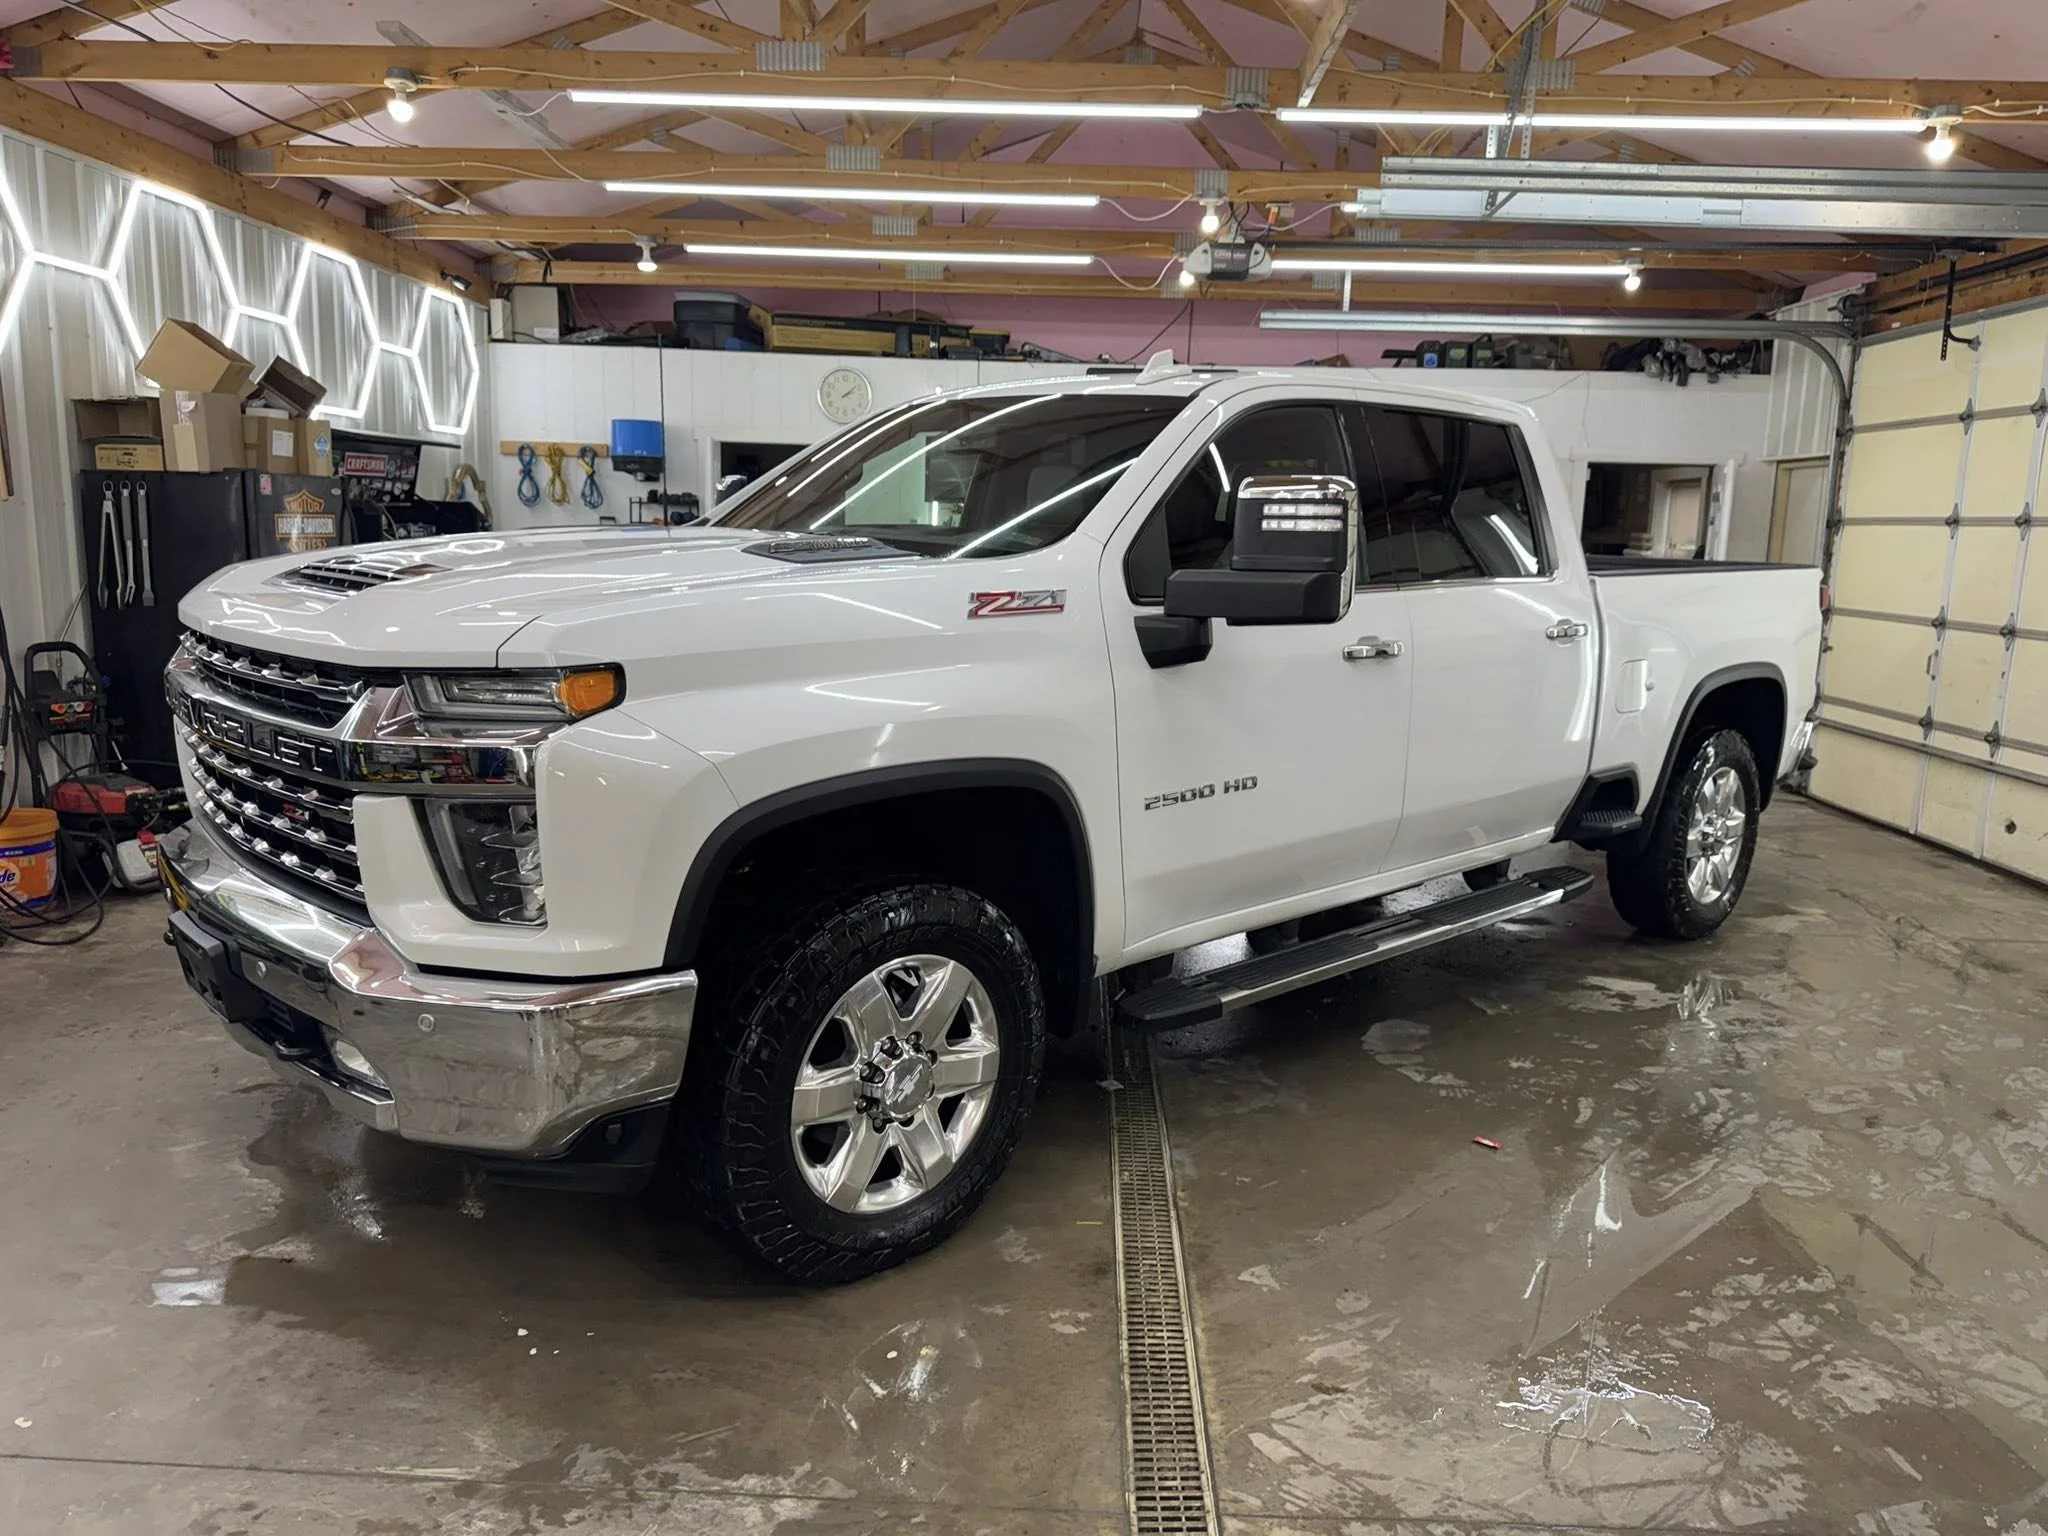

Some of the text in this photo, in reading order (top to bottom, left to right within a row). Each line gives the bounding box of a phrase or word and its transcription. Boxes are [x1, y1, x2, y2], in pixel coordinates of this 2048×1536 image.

[347, 458, 386, 470] CRAFTSMAN
[288, 495, 322, 513] MOTOR
[967, 588, 1068, 620] Z71
[1144, 775, 1258, 811] 2500 HD
[0, 869, 15, 883] de
